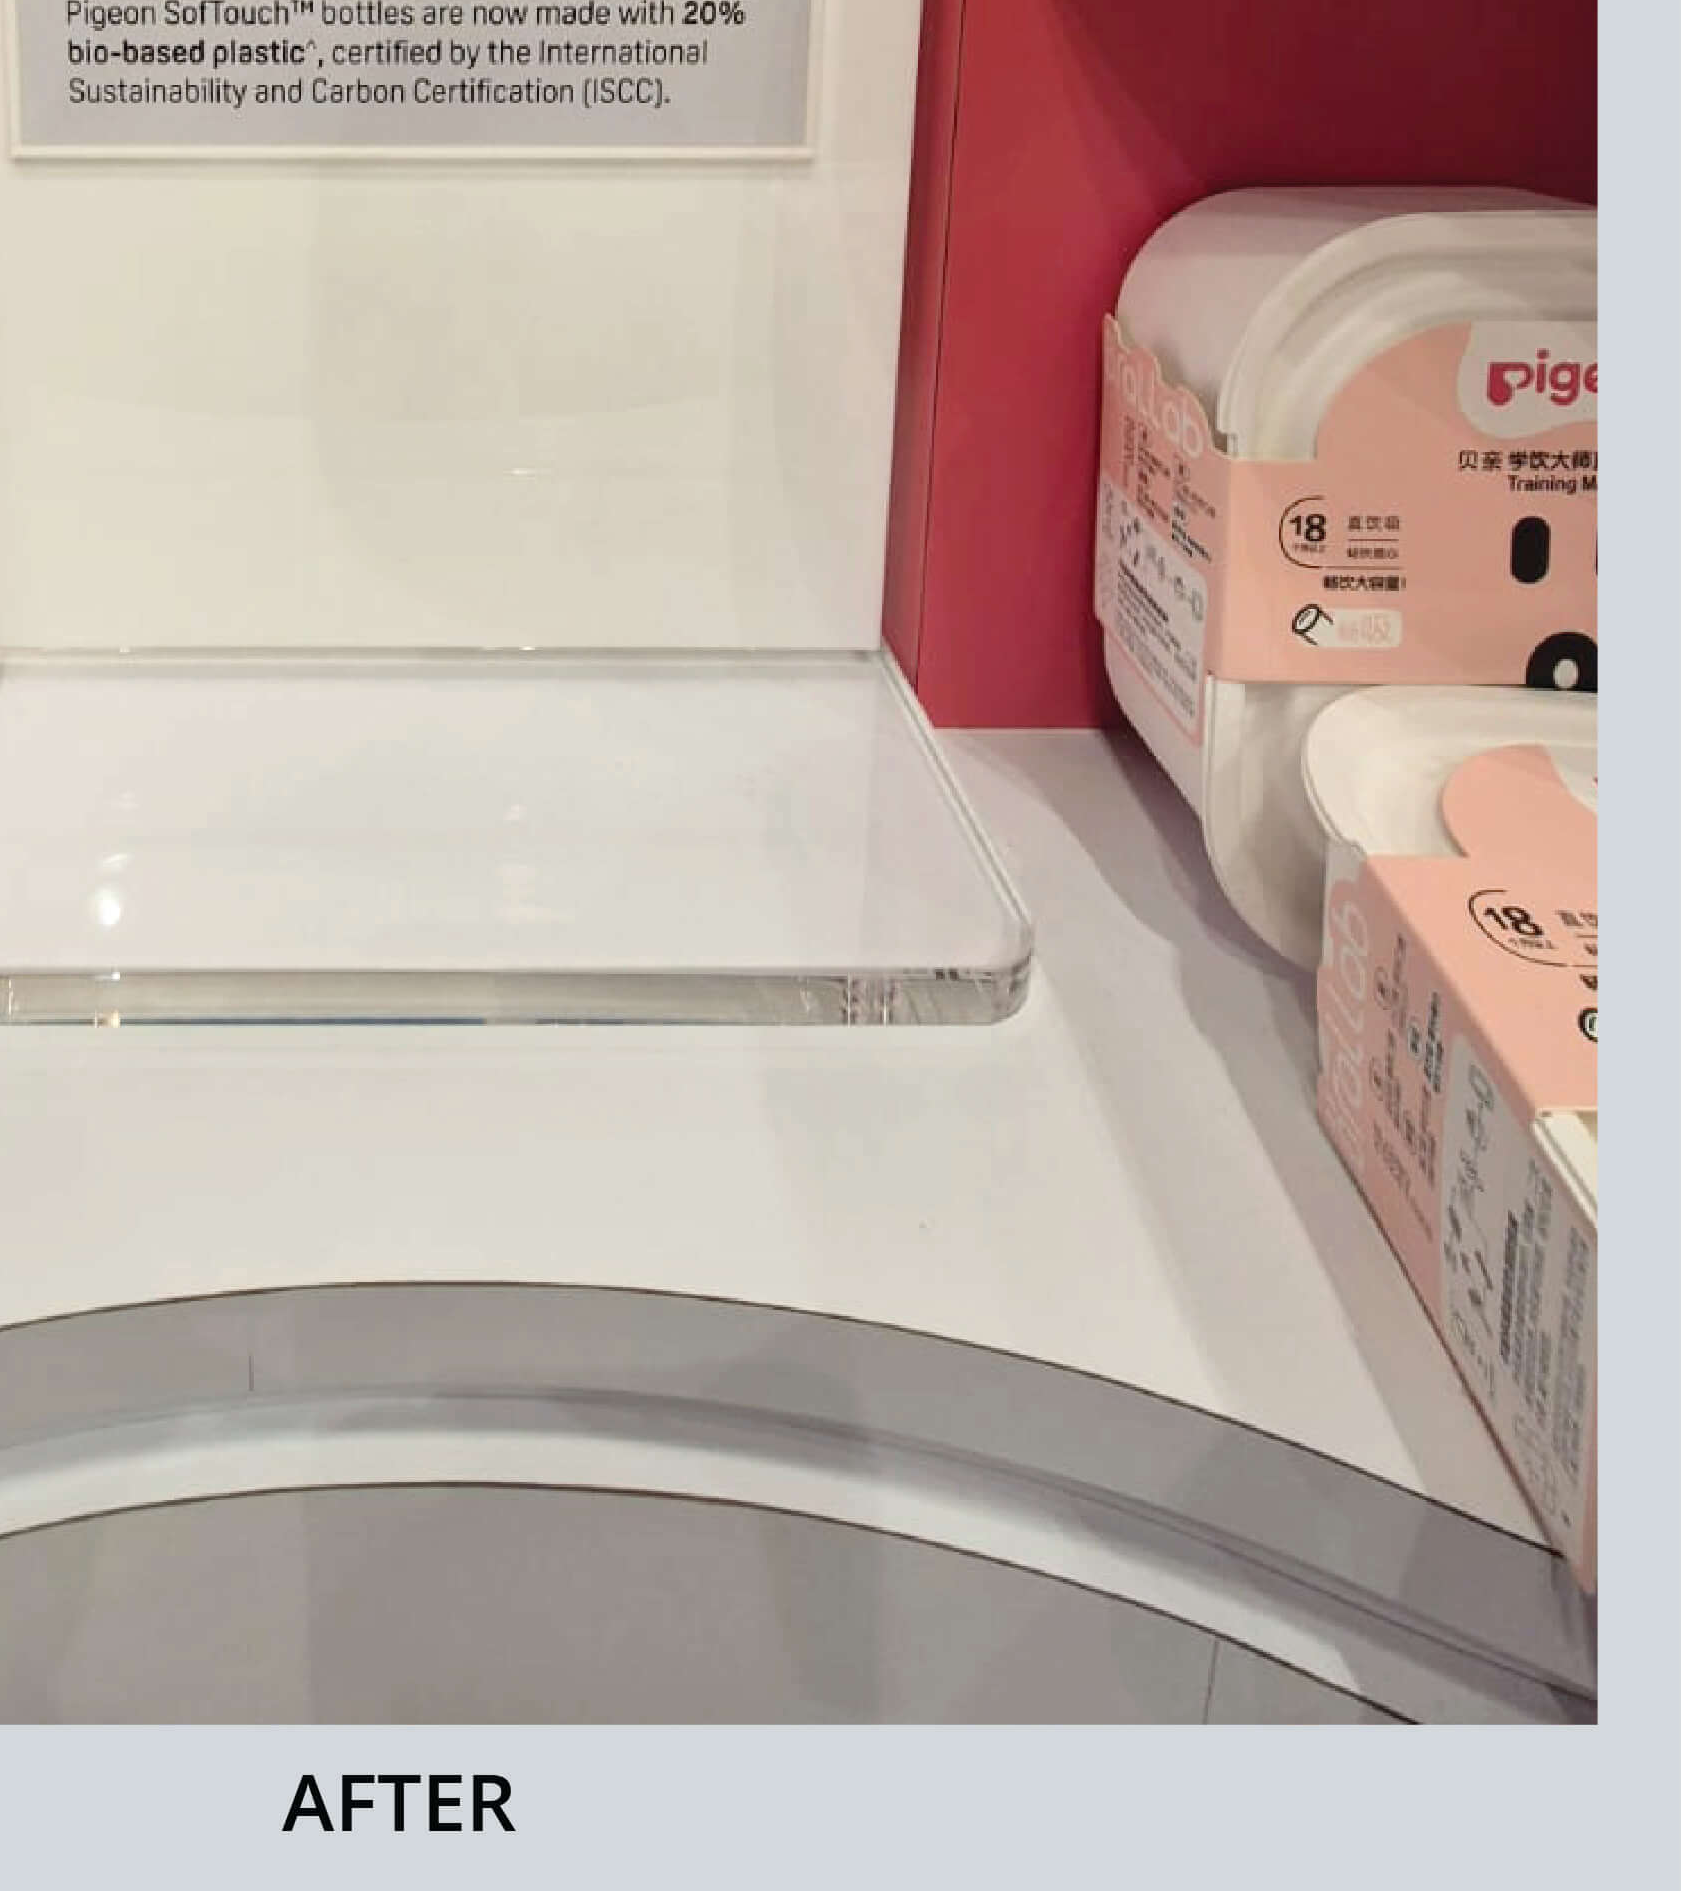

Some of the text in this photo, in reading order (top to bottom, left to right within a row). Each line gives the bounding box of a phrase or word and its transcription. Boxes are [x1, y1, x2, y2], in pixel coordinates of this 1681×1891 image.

[66, 0, 157, 28] Pigeon
[321, 0, 416, 25] bottles
[423, 5, 464, 25] are
[472, 5, 529, 25] now
[535, 0, 612, 25] made
[681, 0, 746, 25] 20%
[67, 39, 206, 65] bio-based
[332, 38, 443, 65] certified
[450, 39, 481, 71] by
[487, 39, 532, 65] the
[538, 38, 709, 65] International
[68, 78, 672, 108] Sustainability and Carbon Certification (ISCC).
[1507, 474, 1577, 495] Training
[1289, 513, 1327, 543] 18
[1483, 905, 1545, 937] 18
